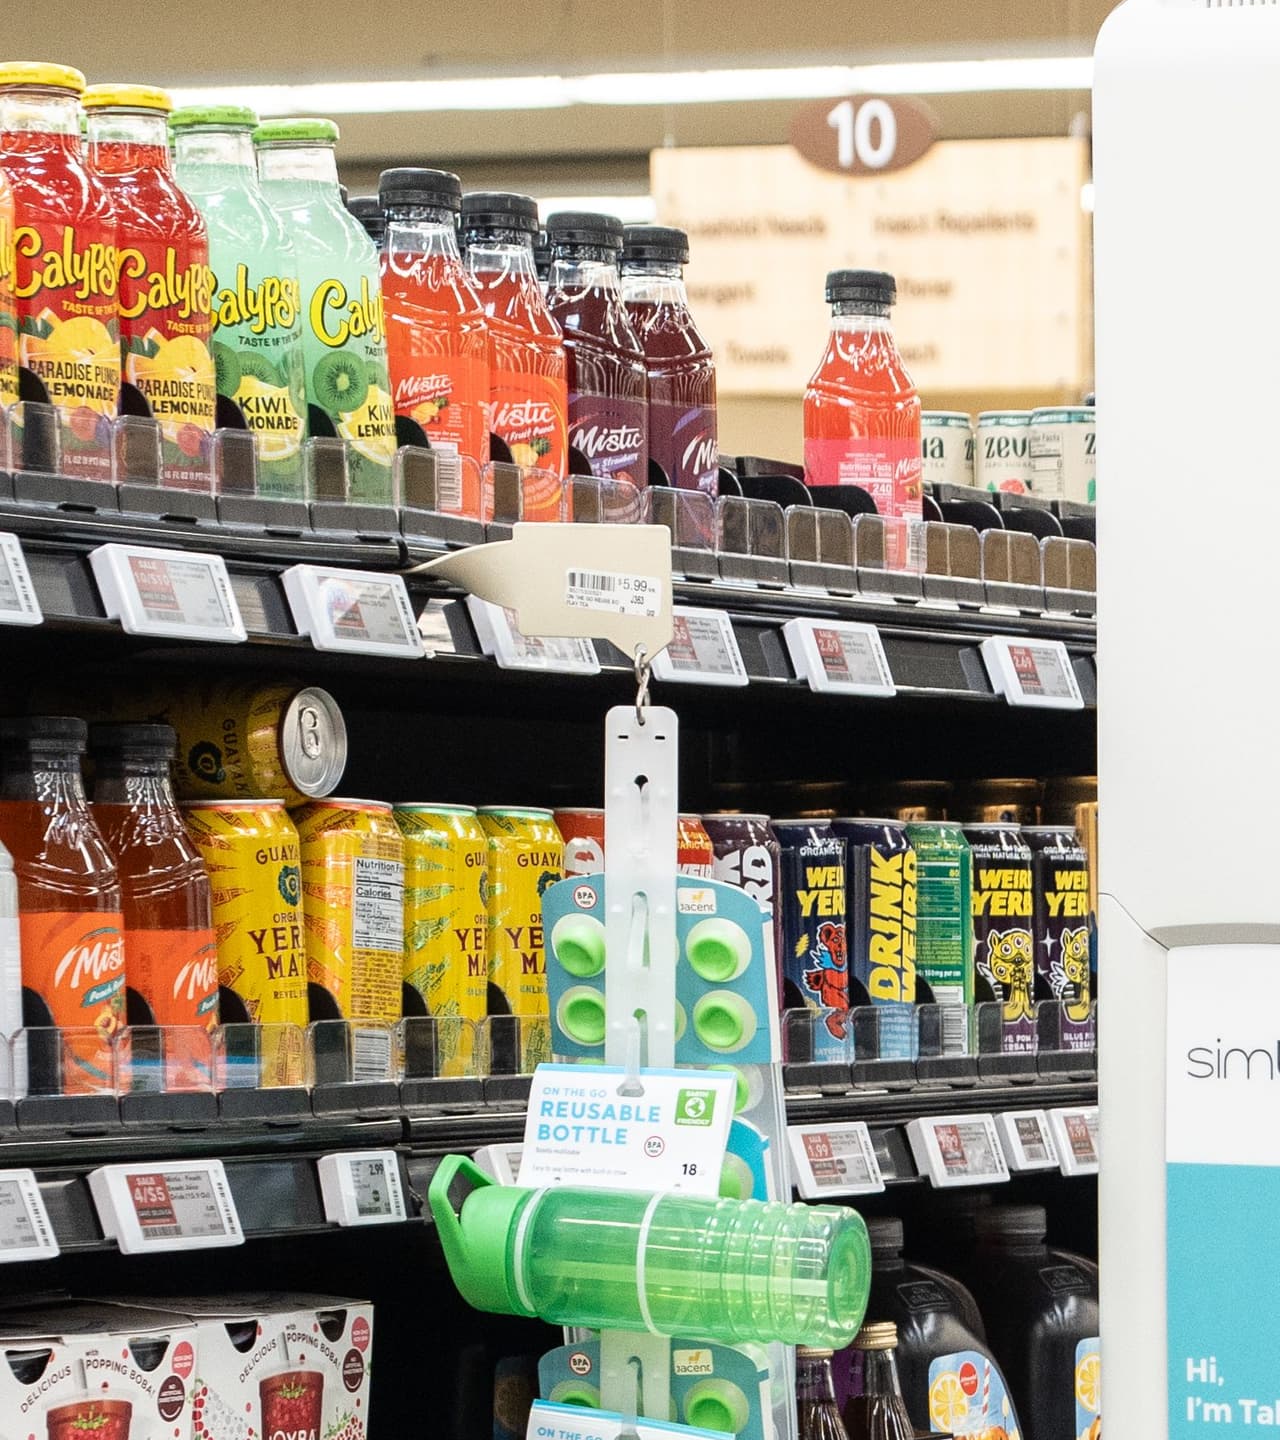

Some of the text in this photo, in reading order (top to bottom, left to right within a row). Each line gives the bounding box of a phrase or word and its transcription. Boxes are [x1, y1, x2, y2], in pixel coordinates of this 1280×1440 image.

[827, 99, 897, 169] 10
[135, 378, 194, 398] PARADISE
[395, 374, 454, 400] Mistic
[239, 396, 287, 414] KIWI
[572, 425, 643, 458] Mistic
[872, 483, 892, 493] 240
[618, 578, 648, 592] $5.99
[819, 639, 839, 652] 2.69
[356, 859, 393, 871] Nutrition
[355, 887, 392, 899] Calories
[576, 892, 594, 901] BPA
[869, 846, 902, 1002] DRINK
[562, 1088, 607, 1098] THE GO
[540, 1100, 661, 1123] REUSABLE
[538, 1124, 628, 1145] BOTTLE
[806, 1142, 828, 1158] 1.99
[368, 1164, 384, 1175] 2.99
[681, 1163, 697, 1176] 18
[134, 1186, 166, 1203] 4/$5
[1186, 1357, 1224, 1387] Hi,
[1187, 1397, 1232, 1425] I'm
[537, 1427, 555, 1438] ON
